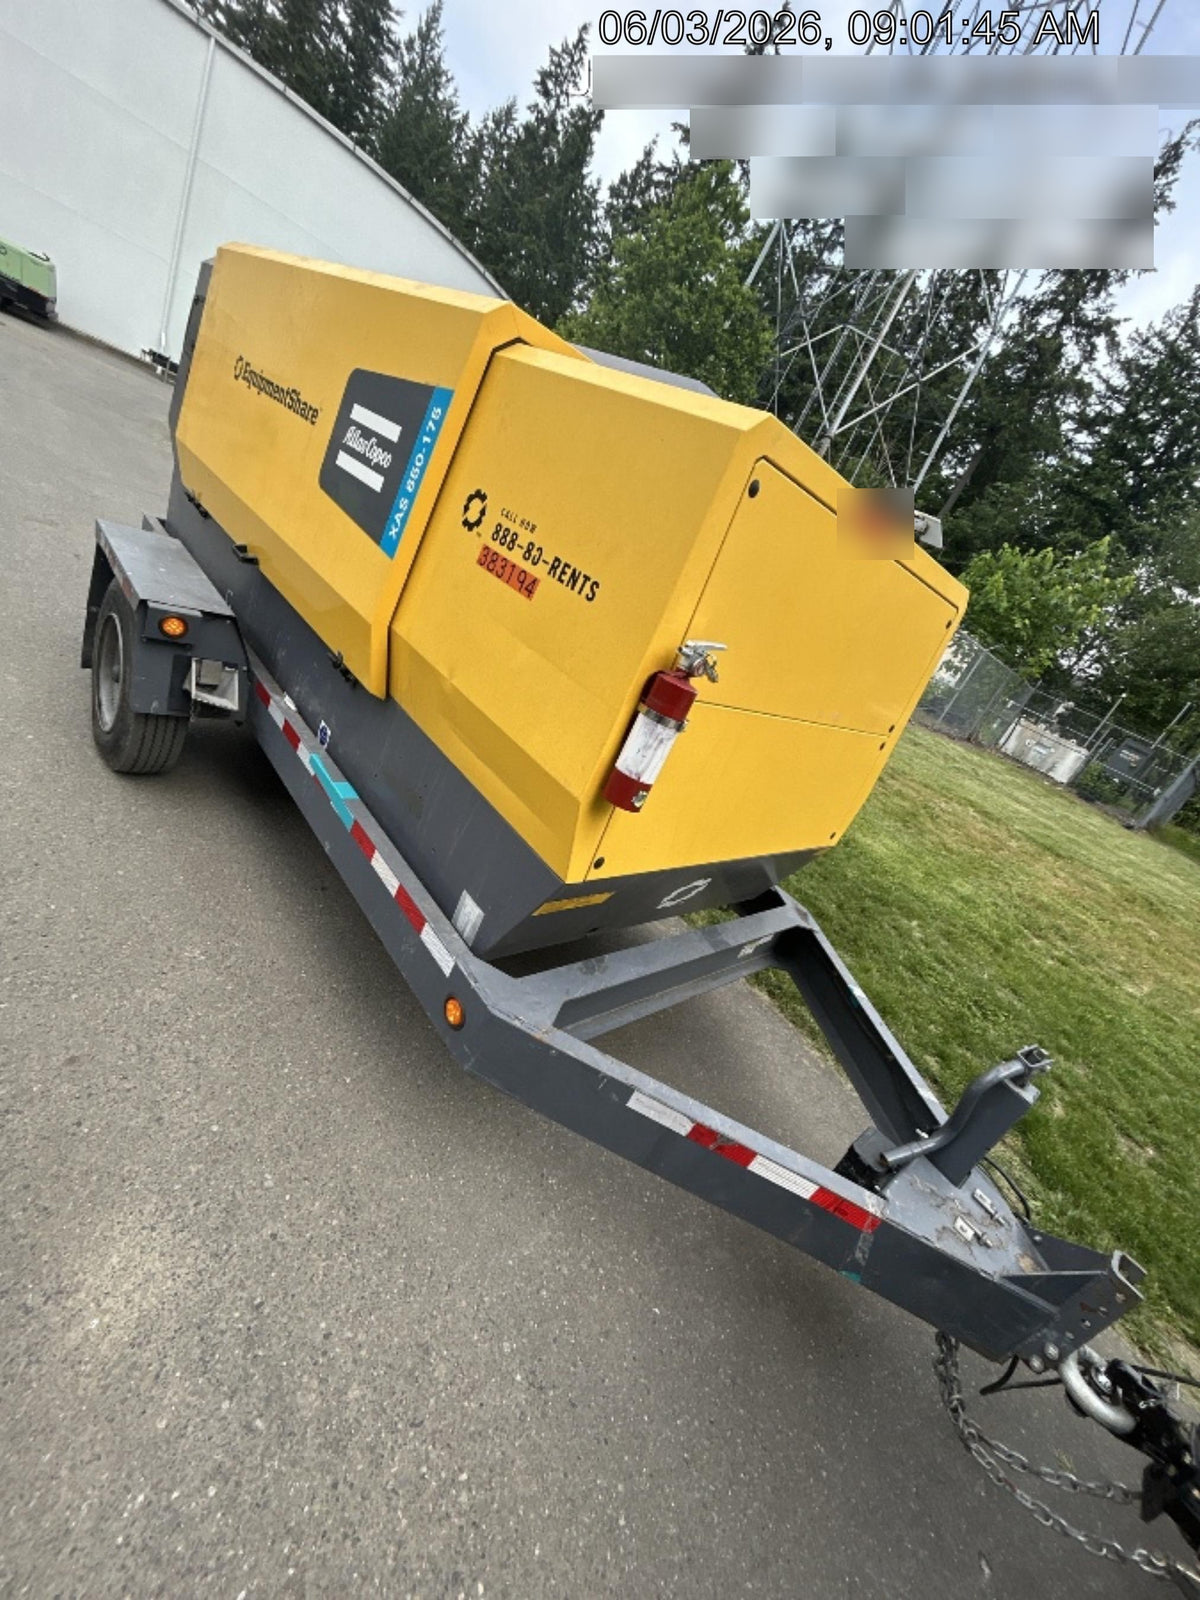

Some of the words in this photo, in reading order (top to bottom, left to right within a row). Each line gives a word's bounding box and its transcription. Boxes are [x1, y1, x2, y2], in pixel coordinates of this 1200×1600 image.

[241, 361, 319, 426] EquipmentShare
[388, 497, 409, 540] XAS
[478, 547, 539, 599] 383194
